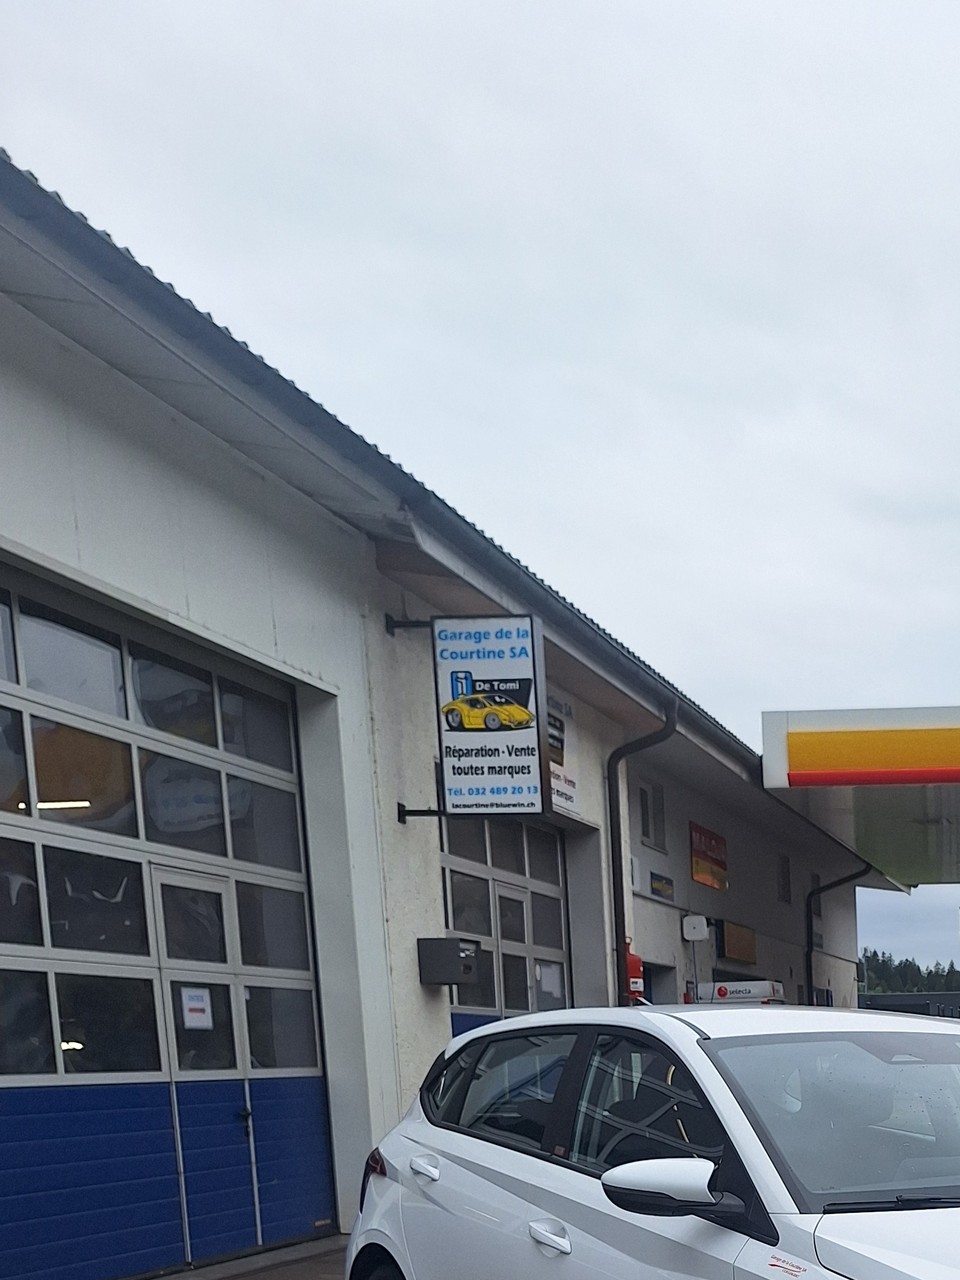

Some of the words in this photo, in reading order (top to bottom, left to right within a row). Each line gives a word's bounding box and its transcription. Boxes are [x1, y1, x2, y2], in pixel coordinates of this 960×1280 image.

[438, 629, 490, 643] Garage
[495, 628, 512, 639] de
[517, 627, 529, 639] la
[440, 648, 505, 660] Courtine
[510, 647, 529, 658] SA
[475, 681, 490, 691] De
[492, 680, 519, 691] Tomi
[445, 745, 500, 761] Réparation
[506, 744, 537, 757] Vente
[452, 764, 485, 776] toutes
[488, 765, 532, 779] marques
[468, 787, 487, 796] 032
[511, 786, 523, 795] 20
[527, 785, 539, 794] 13
[729, 987, 752, 995] selecta
